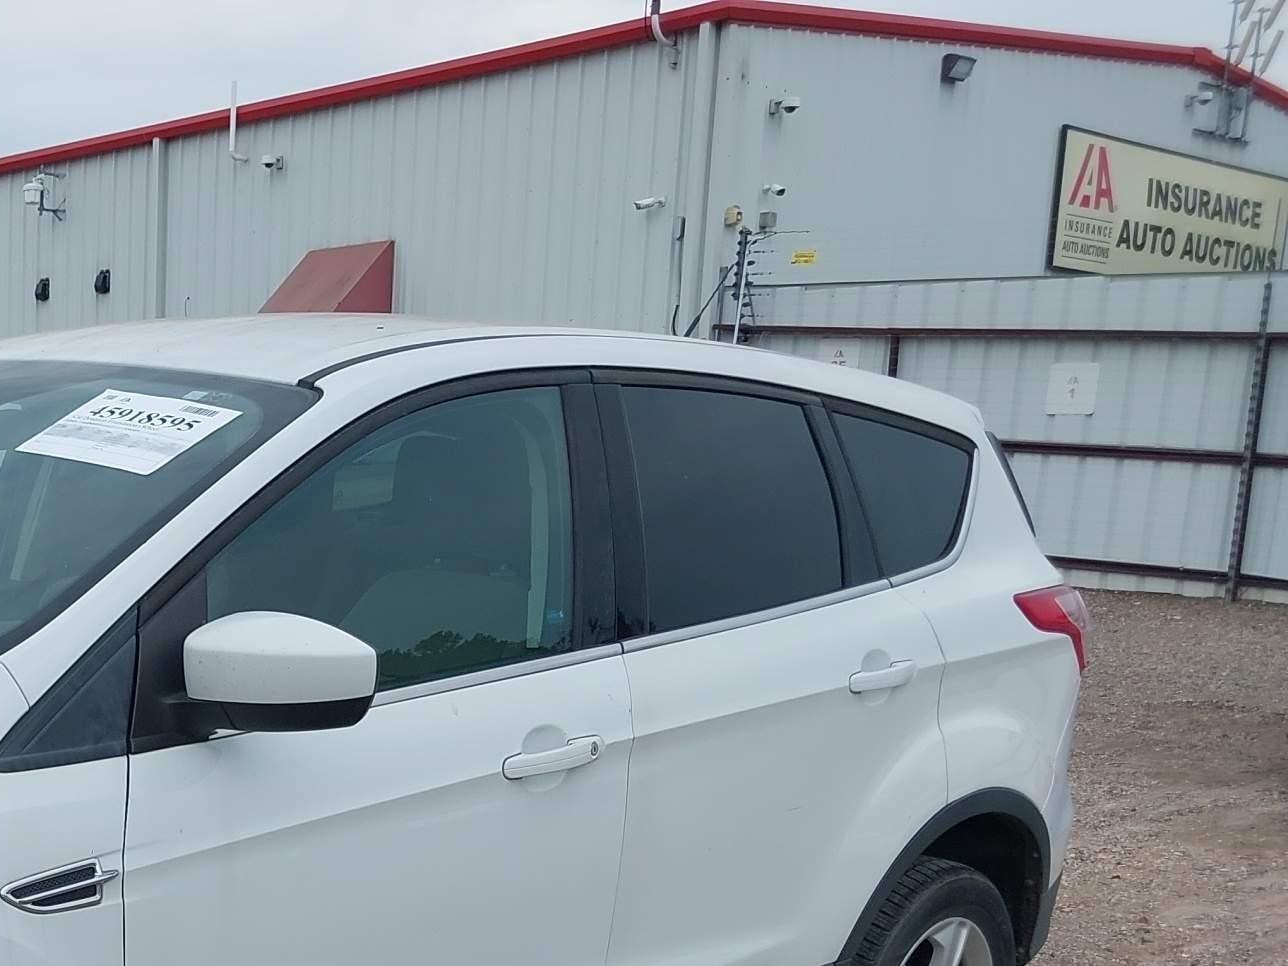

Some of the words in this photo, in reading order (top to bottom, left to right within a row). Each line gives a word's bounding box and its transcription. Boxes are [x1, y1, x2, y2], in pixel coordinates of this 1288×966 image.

[1146, 178, 1263, 230] INSURANCE
[1065, 219, 1113, 239] INSURANCE
[1062, 240, 1079, 254] AUTO
[1079, 243, 1110, 259] AUCTIONS
[1115, 219, 1176, 257] AUTO
[1179, 232, 1277, 272] AUCTIONS
[89, 405, 202, 432] 45918595
